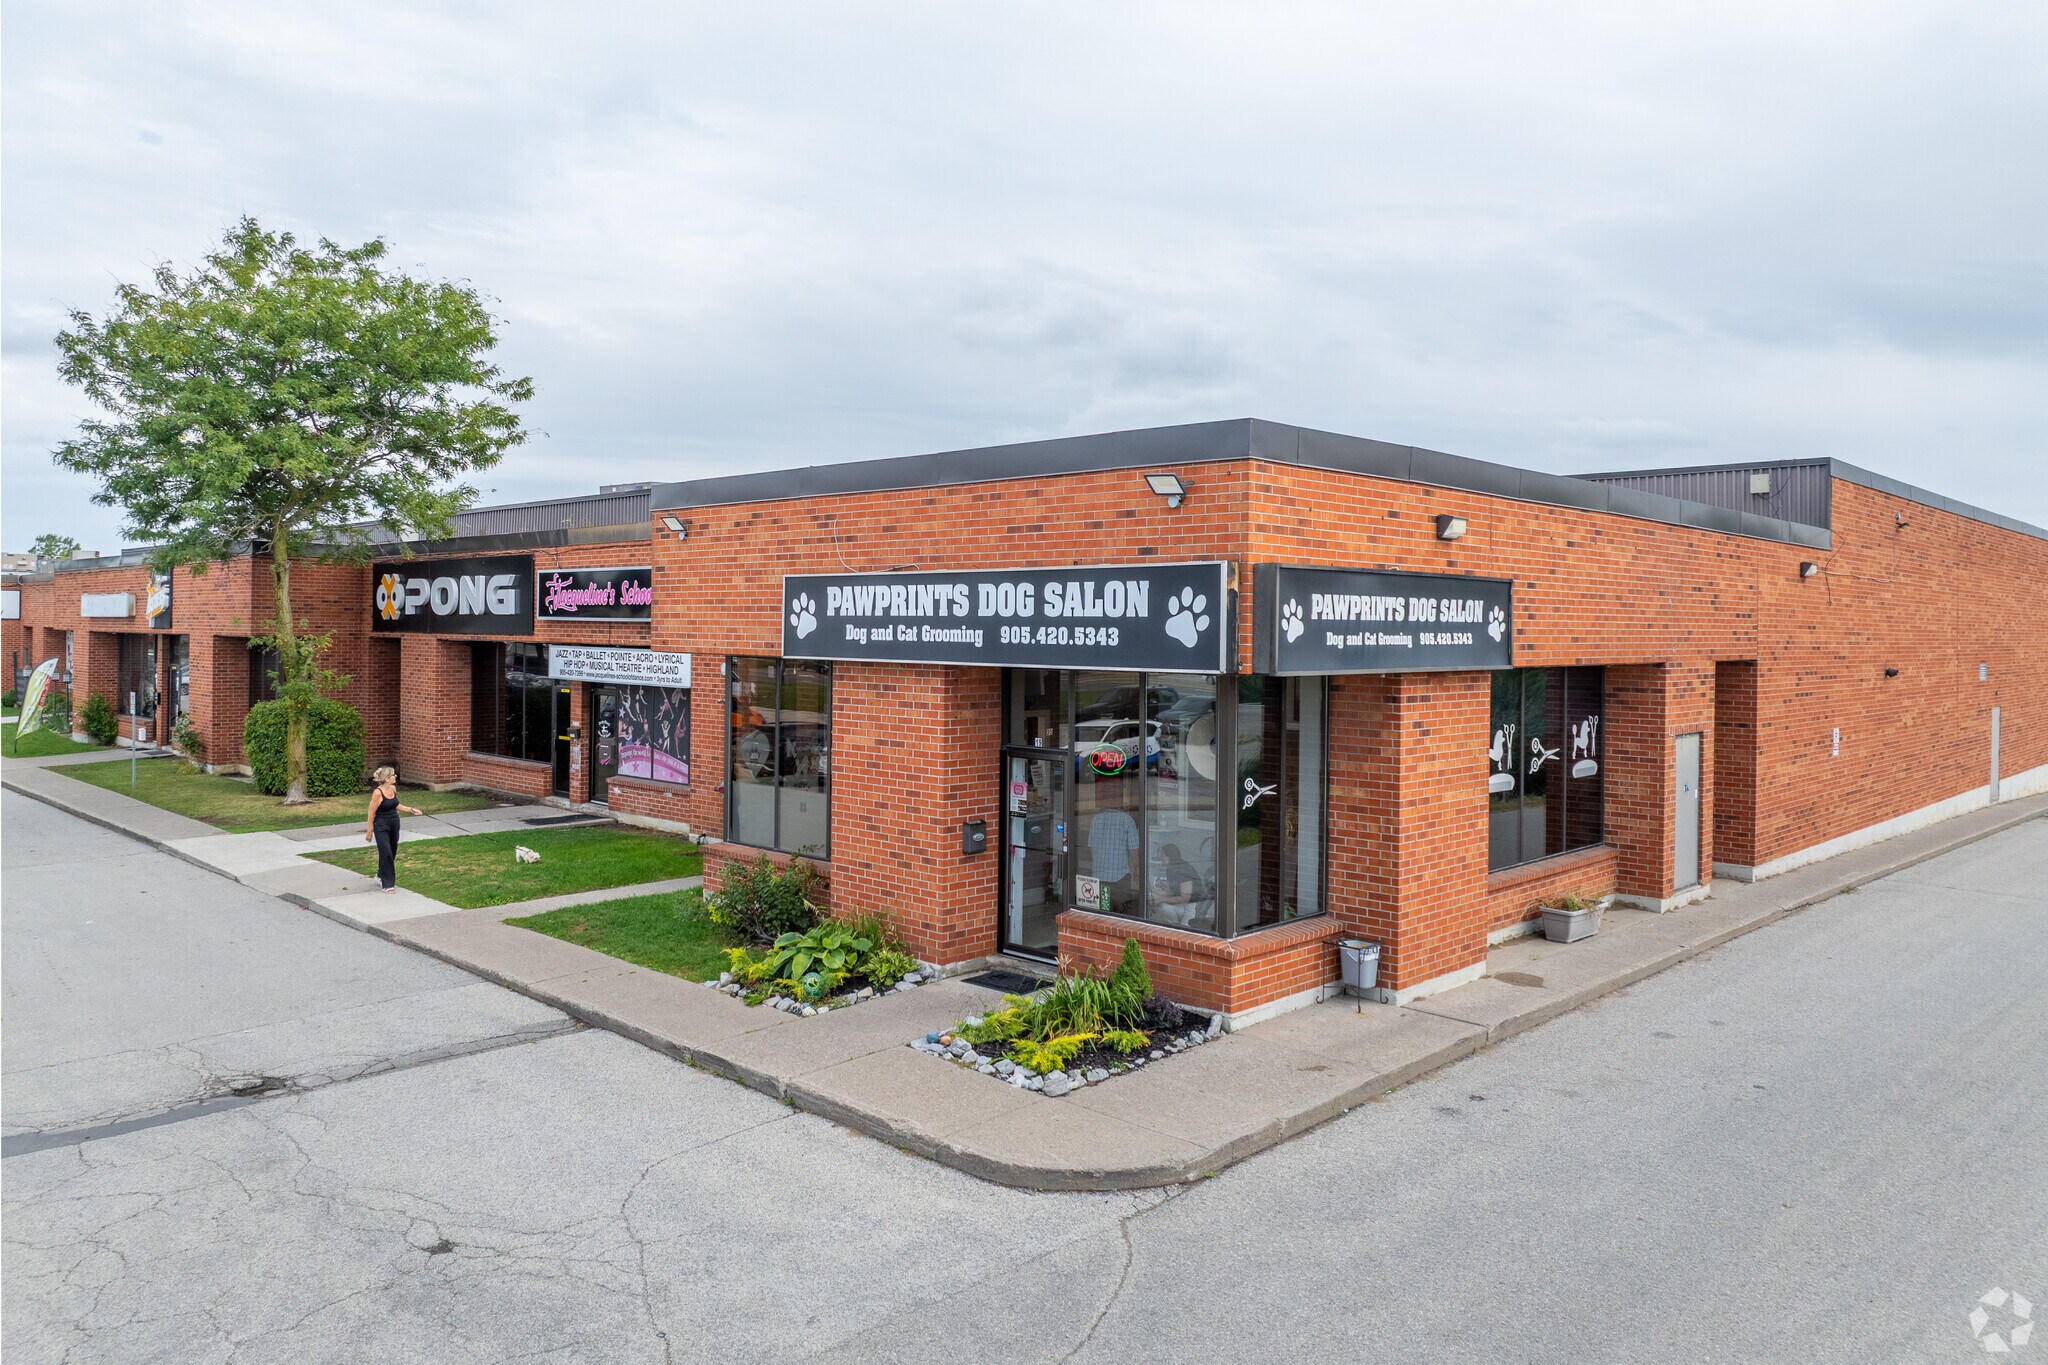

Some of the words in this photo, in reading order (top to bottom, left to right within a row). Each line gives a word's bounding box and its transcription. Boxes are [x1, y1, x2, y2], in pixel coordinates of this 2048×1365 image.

[405, 574, 516, 616] PONG
[620, 580, 651, 605] Schoo
[826, 584, 971, 618] PAWPRINTS
[977, 582, 1035, 617] DOG
[1043, 580, 1150, 618] SALON
[1311, 593, 1405, 622] PAWPRINTS
[1408, 597, 1437, 622] DOG
[1440, 599, 1484, 623] SALON
[845, 624, 868, 645] Dog
[871, 624, 893, 642] and
[897, 624, 918, 642] Cat
[921, 625, 983, 647] Grooming
[1000, 626, 1119, 646] 905.420.5343
[1326, 632, 1344, 649] Dog
[1346, 633, 1363, 646] and
[1364, 632, 1377, 646] Cat
[1378, 632, 1412, 648] Grooming
[1419, 633, 1473, 645] 905.420.5343
[555, 650, 568, 658] JAZZ
[572, 650, 582, 659] TAP
[586, 651, 606, 660] BALLET
[611, 652, 632, 662] POINTE
[636, 653, 653, 663] ACRO
[658, 654, 684, 664] LYRICAL
[564, 660, 573, 668] HIP
[574, 661, 585, 669] HOP
[590, 661, 614, 671] MUSICAL
[615, 663, 642, 673] THEATRE
[646, 665, 679, 675] HIGHLAND
[1091, 751, 1123, 768] OPEN
